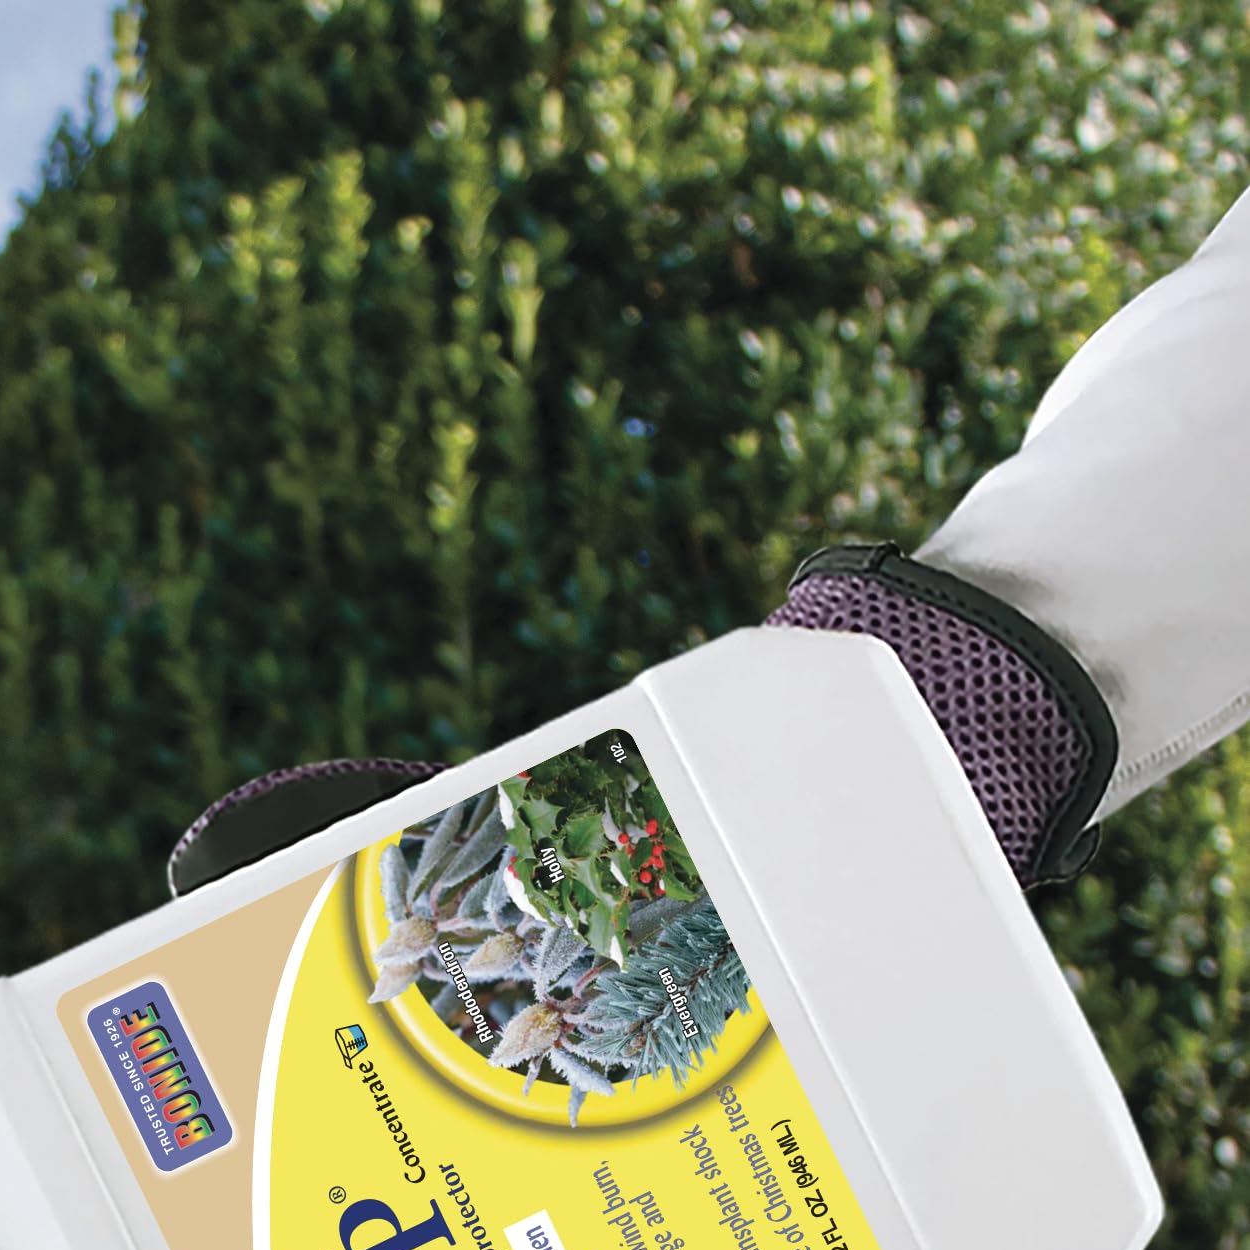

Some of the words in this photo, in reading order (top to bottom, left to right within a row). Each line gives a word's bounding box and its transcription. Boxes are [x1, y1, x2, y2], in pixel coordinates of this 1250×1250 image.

[610, 742, 628, 764] 102
[539, 846, 565, 884] Holly
[437, 941, 495, 1043] Rhododendron
[658, 967, 699, 1039] Evergreen
[103, 1018, 123, 1048] 1926
[118, 1051, 144, 1092] SINCE
[140, 1094, 174, 1156] TRUSTED
[358, 1060, 426, 1184] Concentrate
[715, 1084, 751, 1134] trees
[679, 1124, 722, 1180] shock
[787, 1155, 819, 1189] (946
[593, 1160, 626, 1215] burn,
[739, 1133, 792, 1223] Christmas
[628, 1190, 665, 1227] and
[773, 1223, 804, 1244] of
